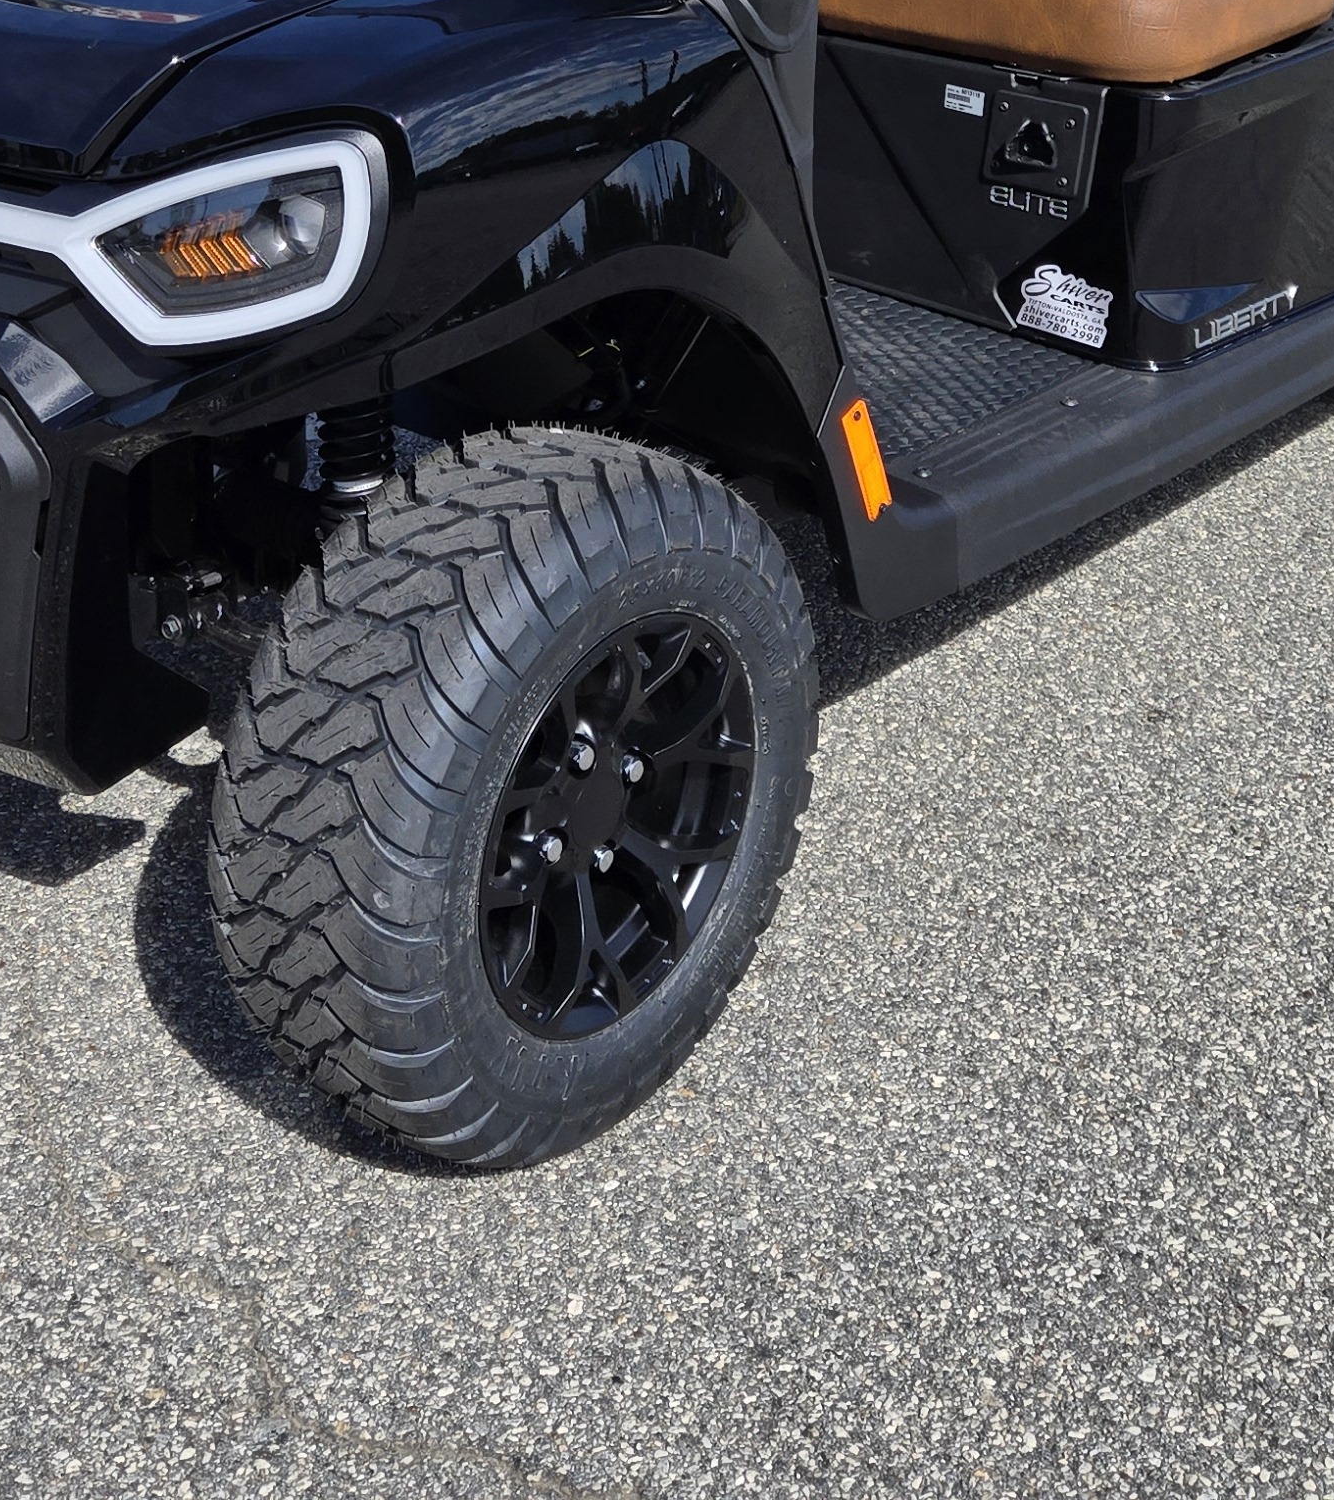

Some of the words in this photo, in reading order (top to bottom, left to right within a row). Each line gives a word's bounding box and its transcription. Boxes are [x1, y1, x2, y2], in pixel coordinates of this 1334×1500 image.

[990, 185, 1068, 221] ELITE
[1025, 268, 1110, 304] Shiver
[1024, 304, 1104, 335] shivercarts.com
[1050, 294, 1106, 315] CARTS
[1194, 285, 1299, 349] LIBERTY
[1021, 313, 1100, 344] 888-780-2998
